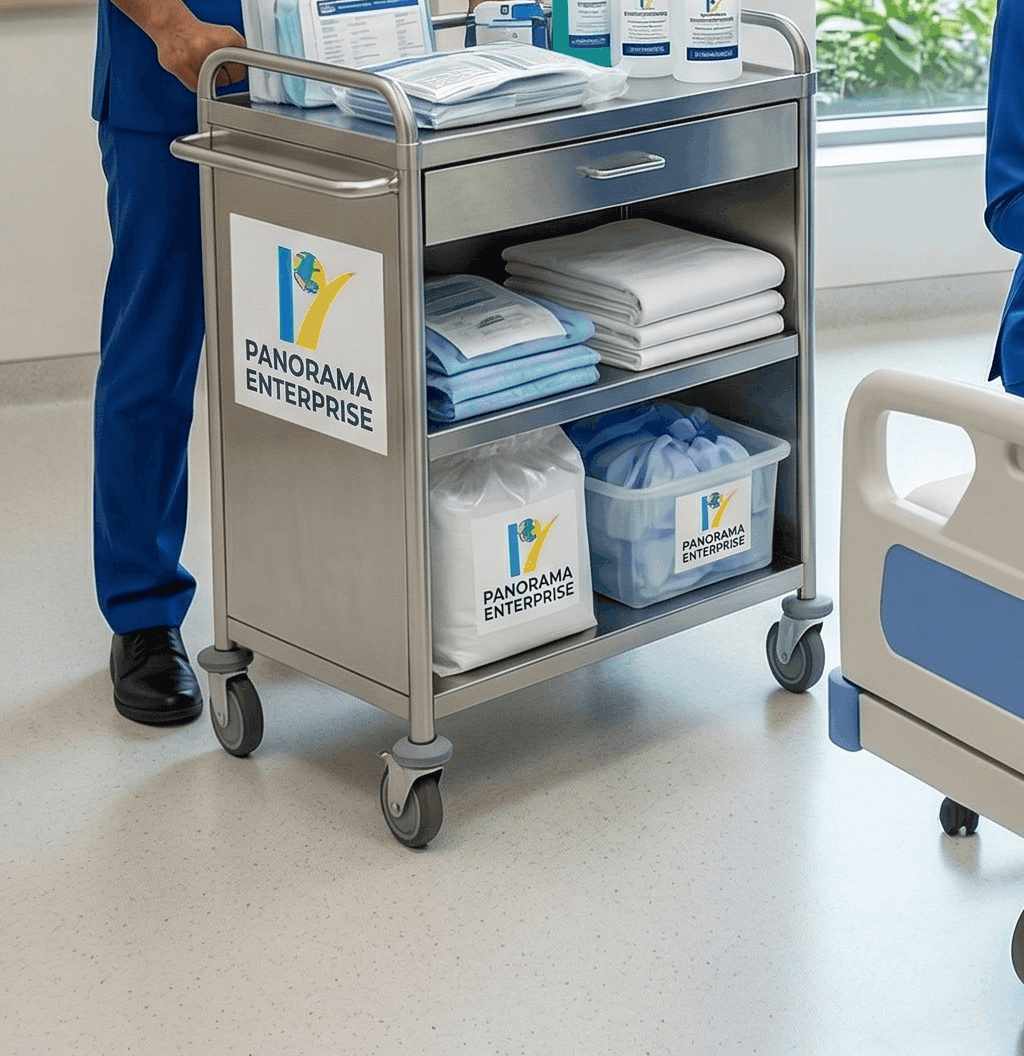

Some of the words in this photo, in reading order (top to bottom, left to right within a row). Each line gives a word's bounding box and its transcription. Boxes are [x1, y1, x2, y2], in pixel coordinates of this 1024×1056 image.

[245, 338, 373, 402] PANORAMA
[246, 367, 374, 433] ENTERPRISE
[682, 523, 745, 552] PANORAMA
[682, 534, 746, 564] ENTERPRISE
[483, 565, 573, 605] PANORAMA
[484, 581, 575, 622] ENTERPRISE
